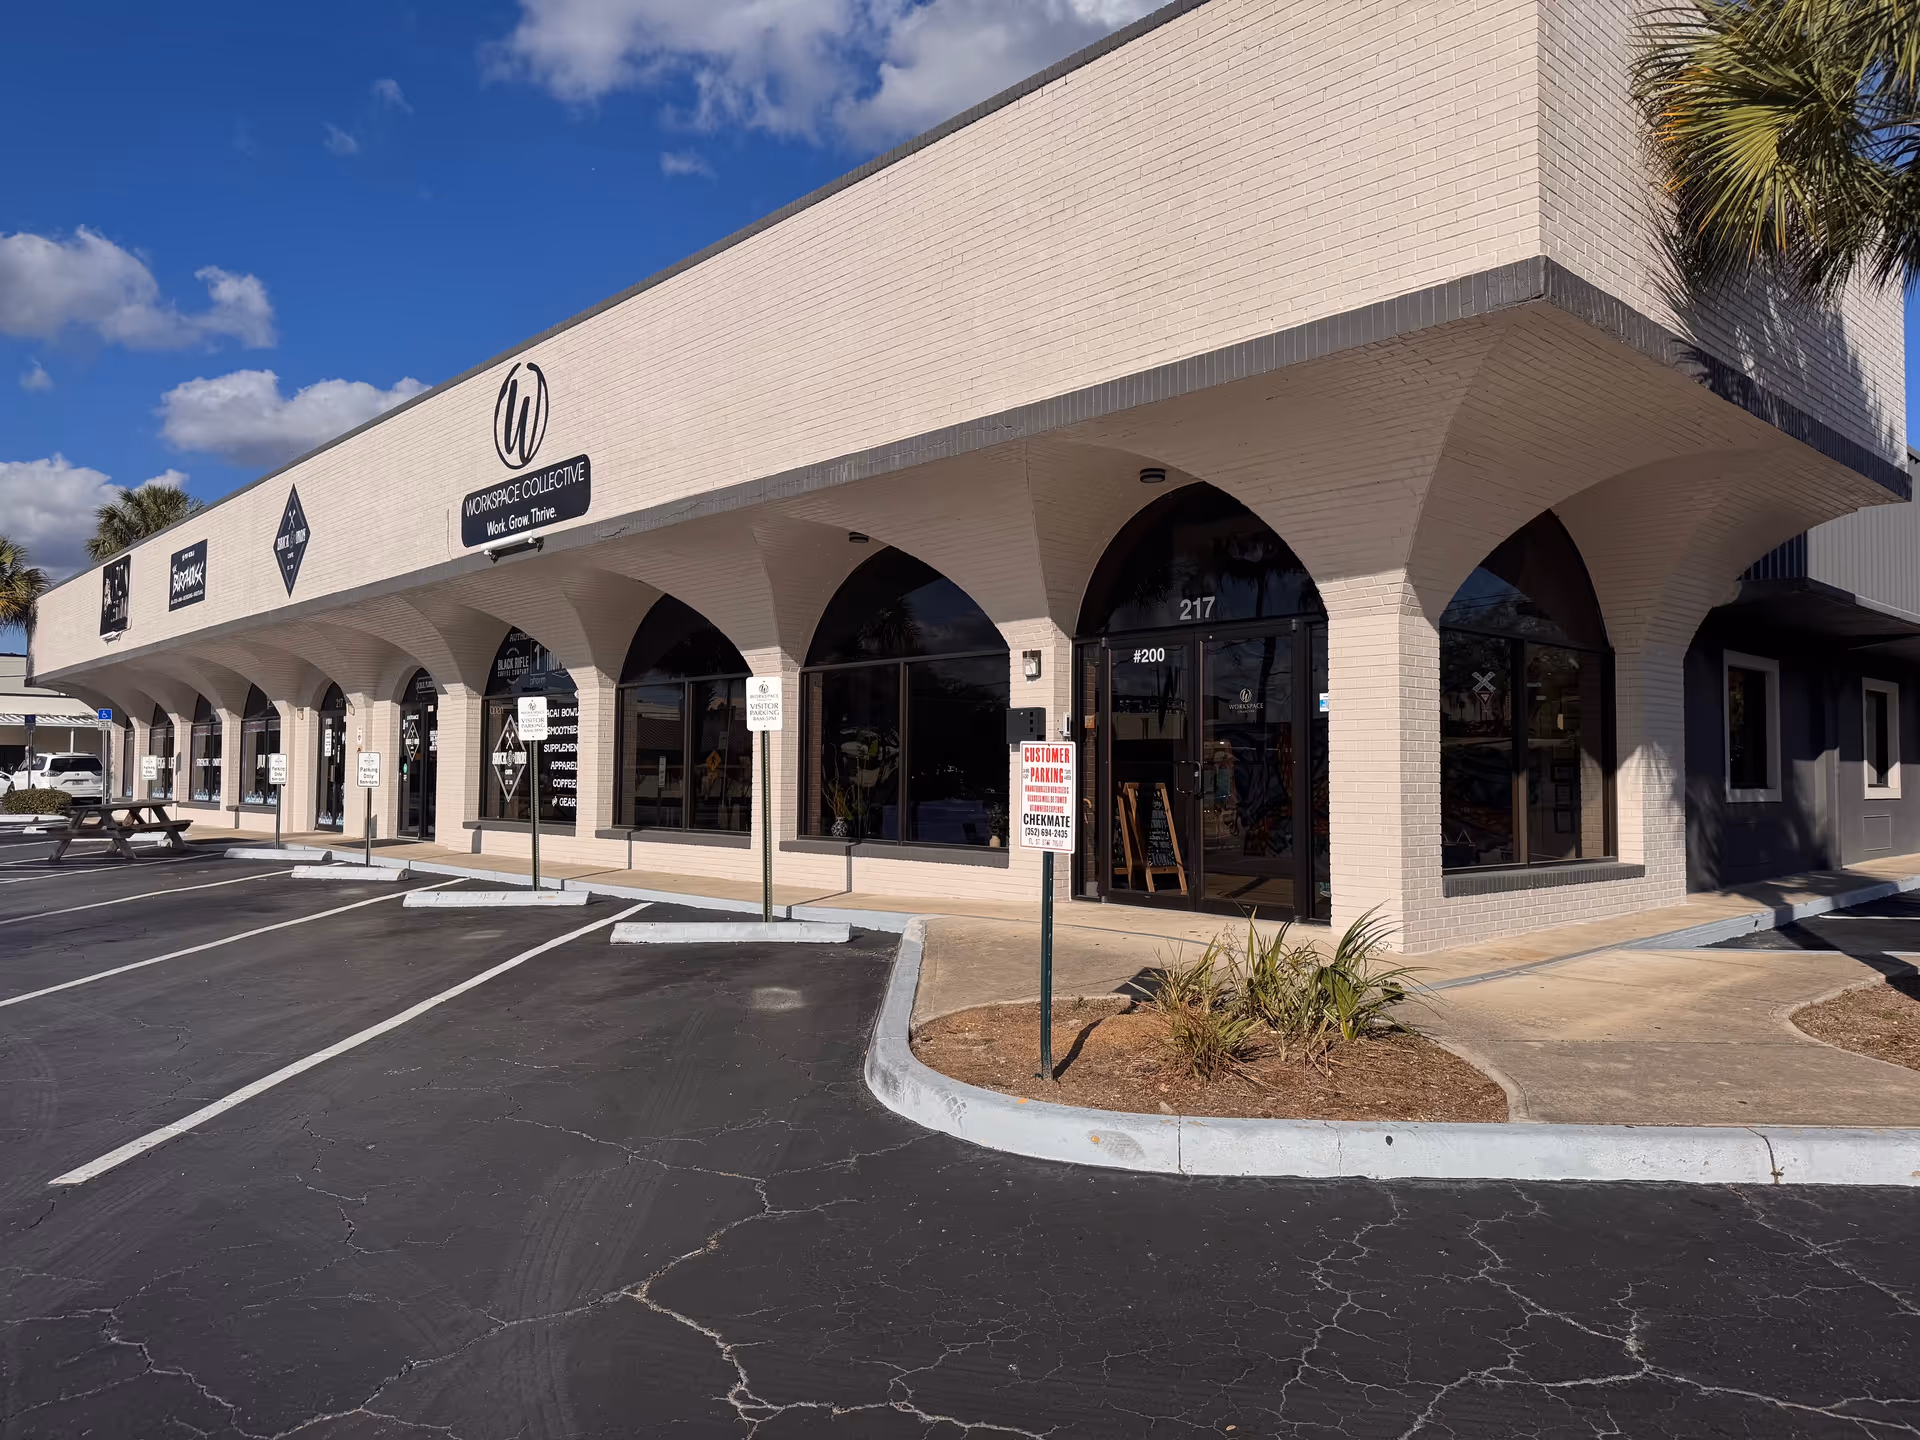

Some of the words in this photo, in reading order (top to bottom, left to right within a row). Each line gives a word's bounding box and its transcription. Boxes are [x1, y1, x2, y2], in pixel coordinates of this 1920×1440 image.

[465, 483, 520, 517] WORKSPACE
[522, 462, 585, 499] COLLECTIVE
[487, 519, 507, 536] Work.
[508, 513, 529, 530] Grow.
[531, 507, 557, 524] Thrive.
[1179, 596, 1216, 621] 217
[1133, 648, 1165, 663] #200
[497, 658, 513, 671] BLACK
[514, 656, 530, 668] RIFLE
[749, 702, 779, 710] VISITOR
[1228, 702, 1264, 710] WORKSPACE
[1024, 747, 1070, 763] CUSTOMER
[550, 761, 577, 770] APPAREL
[1030, 767, 1064, 783] PARKING
[552, 778, 577, 788] COFFEE
[559, 797, 577, 807] GEAR
[1023, 813, 1071, 828] CHEKMATE
[1025, 827, 1040, 837] (352)
[1041, 828, 1068, 838] 694-2435
